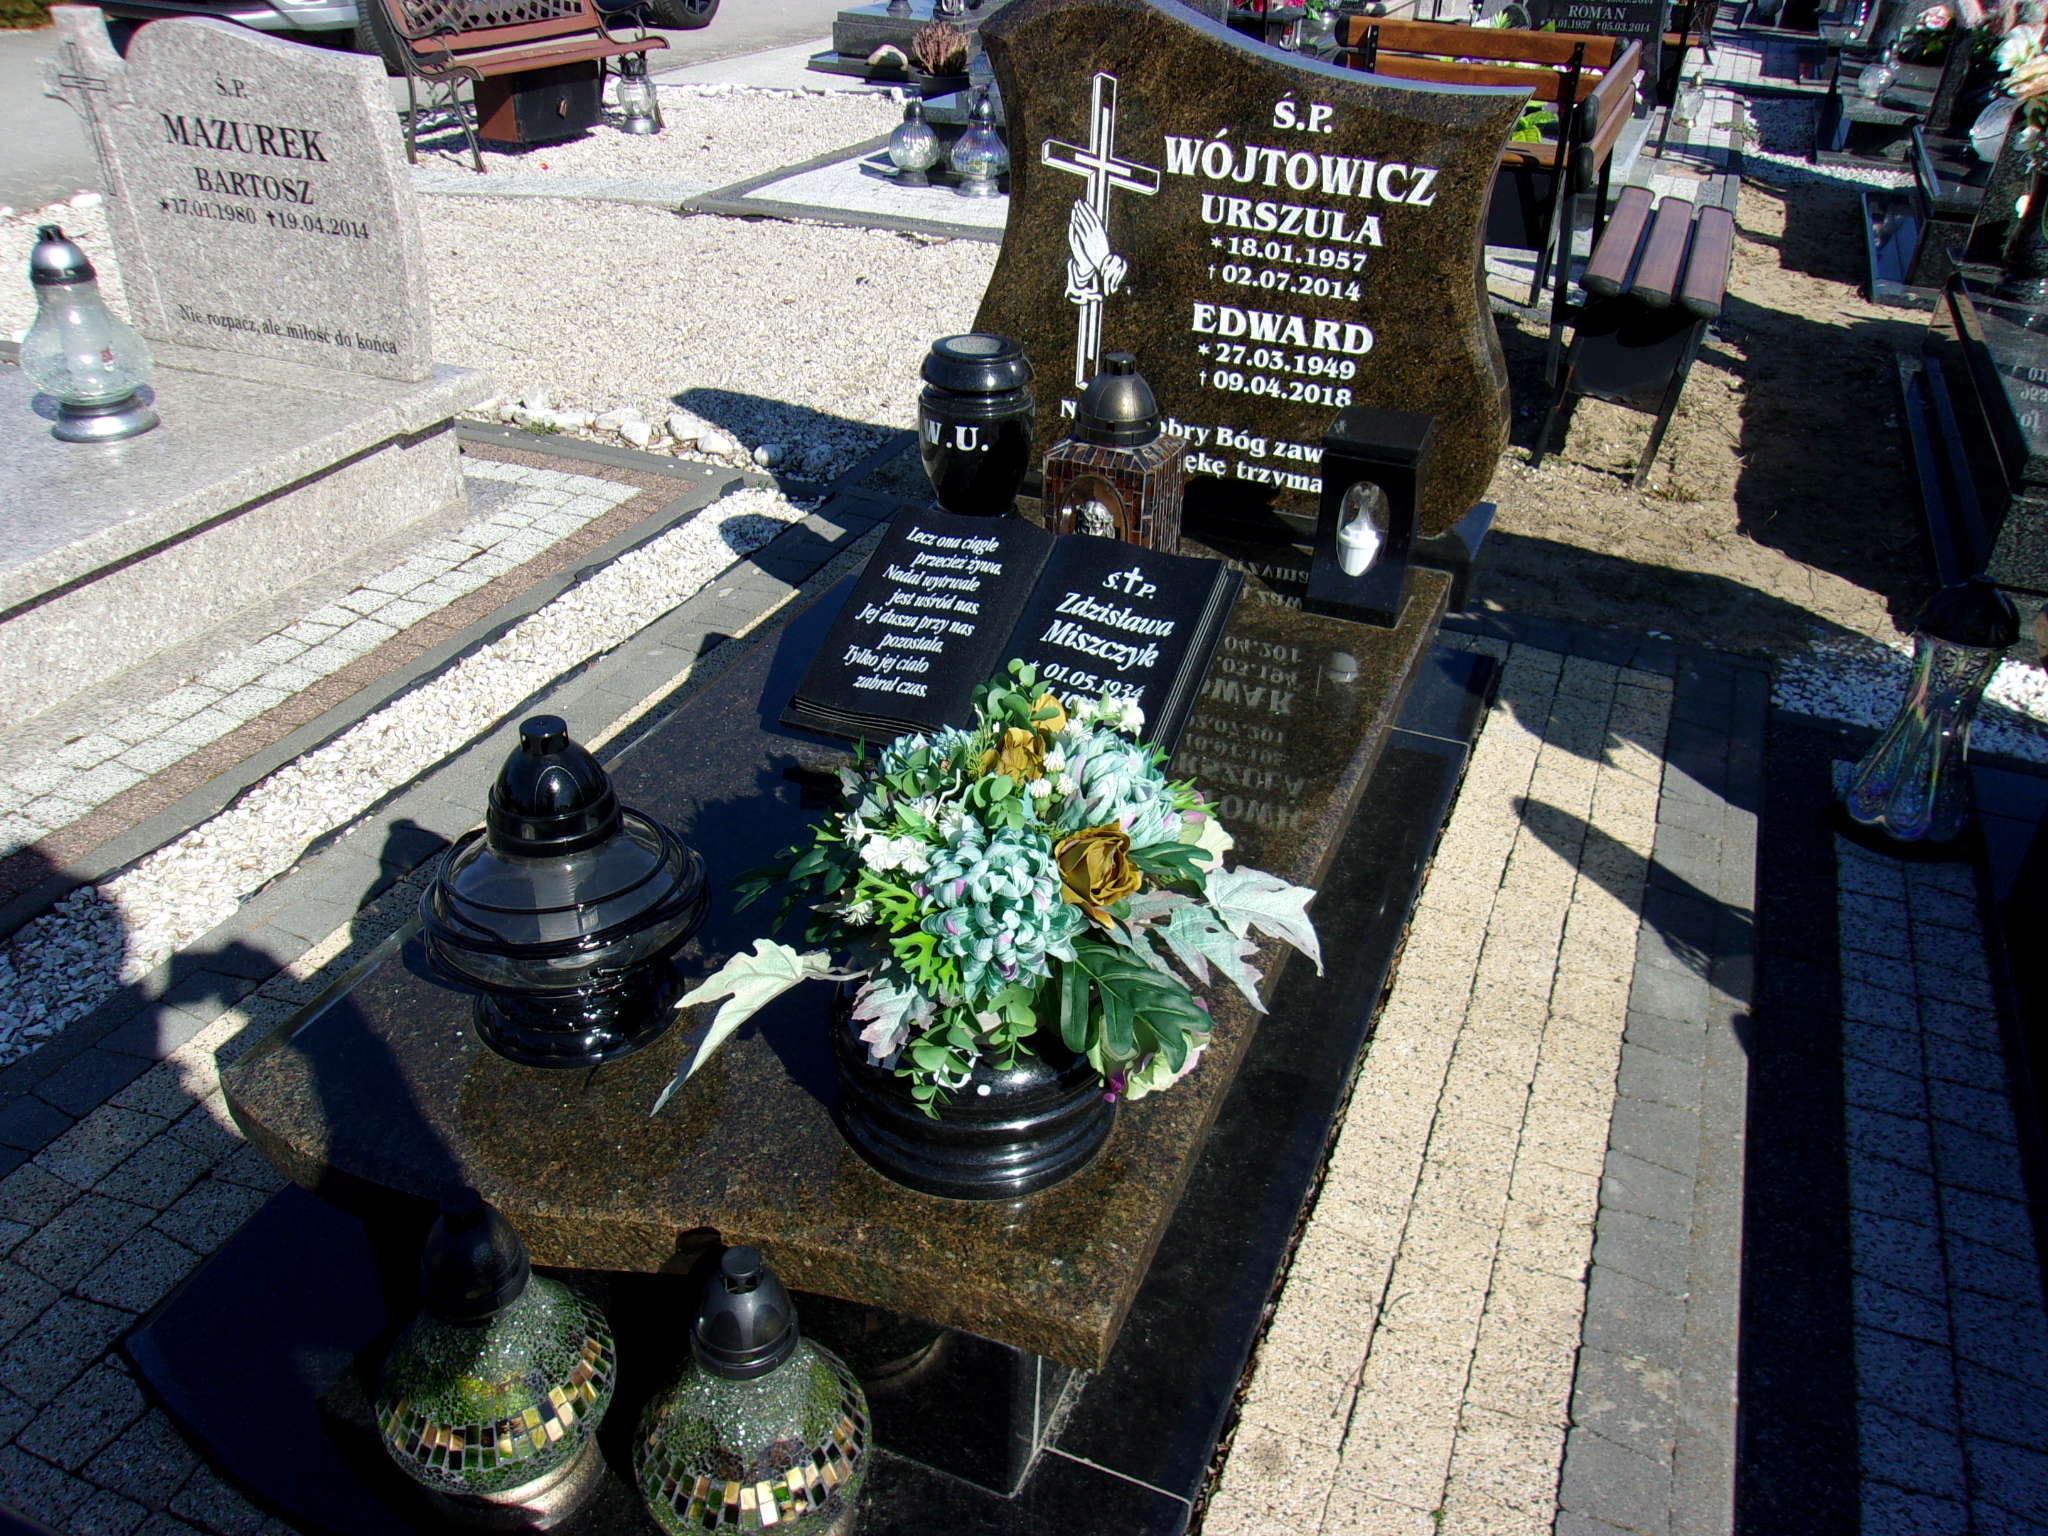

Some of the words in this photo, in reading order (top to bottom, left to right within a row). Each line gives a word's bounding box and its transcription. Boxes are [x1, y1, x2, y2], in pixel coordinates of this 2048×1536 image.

[1568, 5, 1626, 20] ROMAN
[1273, 92, 1333, 134] Ś.P.
[160, 113, 328, 162] MAZUREK
[194, 167, 314, 205] BARTOSZ
[1164, 127, 1440, 207] WÓJTOWICZ
[1201, 194, 1383, 246] URSZULA
[178, 304, 201, 323] Nie
[263, 318, 281, 336] ale
[335, 329, 351, 347] do
[356, 332, 398, 355] końca
[1192, 303, 1374, 355] EDWARD
[1216, 426, 1267, 458] Bóg
[1273, 441, 1325, 463] zaw
[1185, 452, 1226, 480] ękę
[1237, 460, 1322, 494] trzyma
[906, 526, 938, 546] Lecz
[936, 536, 962, 549] ona
[961, 535, 1000, 555] ciągle
[882, 564, 926, 585] Nadal
[922, 575, 980, 592] wytrwale
[909, 551, 968, 570] przecież
[855, 603, 882, 624] Jej
[879, 609, 918, 628] dusza
[913, 615, 948, 635] przy
[949, 620, 976, 637] nas
[885, 588, 916, 606] jest
[916, 592, 958, 611] wśród
[953, 600, 980, 615] nas.
[1055, 592, 1175, 637] Zdzisława
[843, 644, 879, 666] Tylko
[873, 653, 900, 674] jej
[896, 655, 929, 673] ciało
[1040, 619, 1160, 672] Miszczyk
[896, 681, 928, 697] czas.
